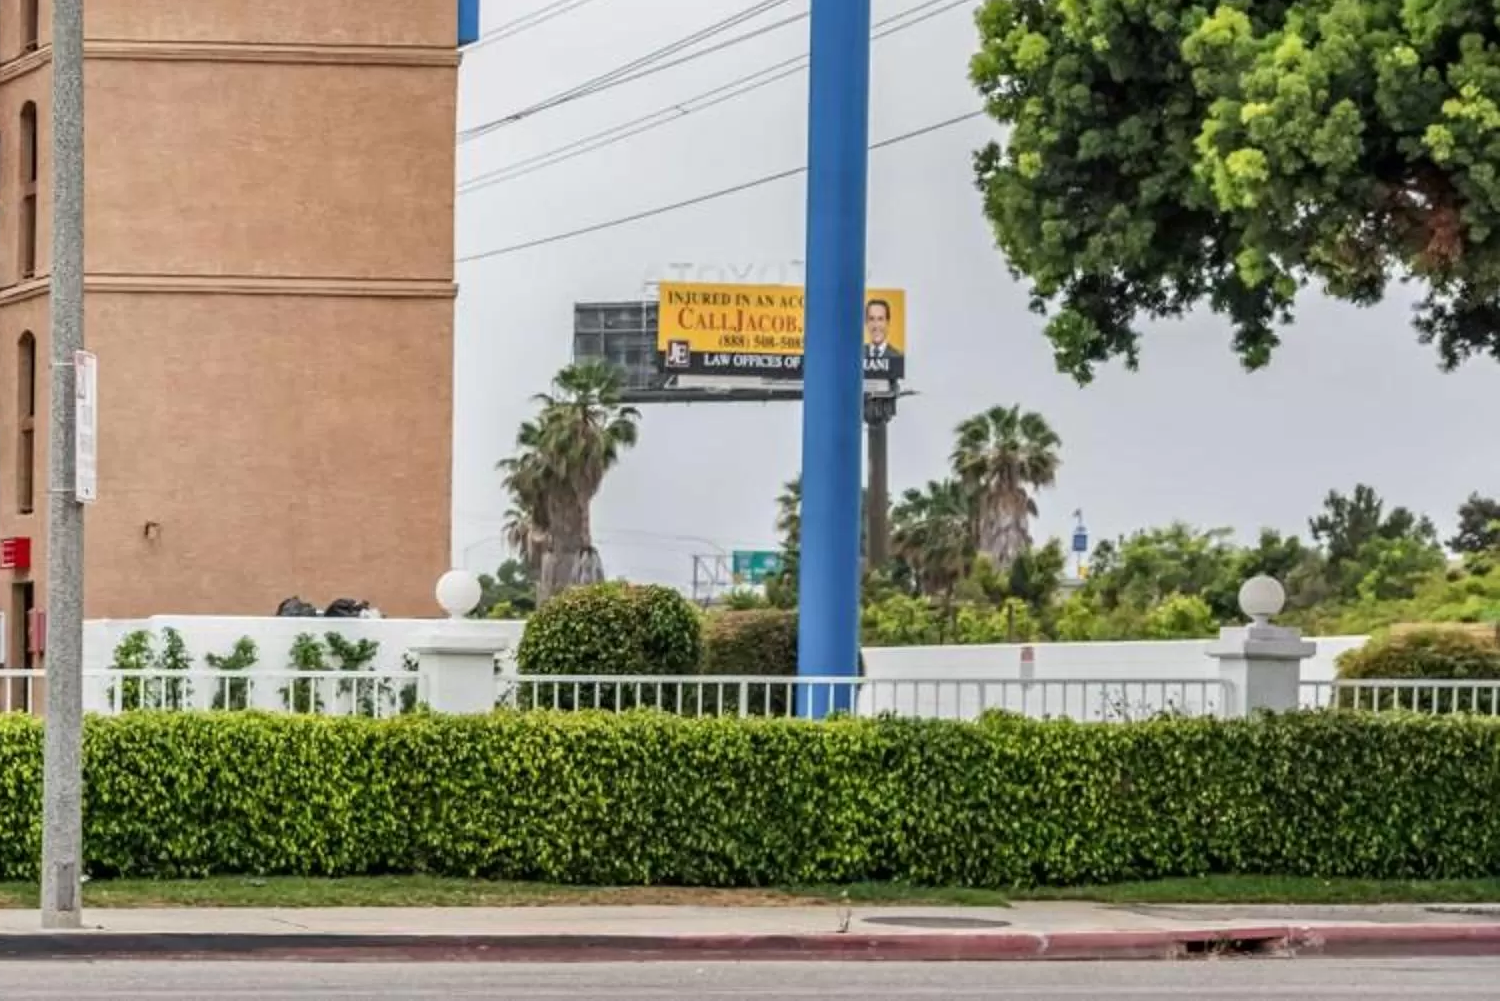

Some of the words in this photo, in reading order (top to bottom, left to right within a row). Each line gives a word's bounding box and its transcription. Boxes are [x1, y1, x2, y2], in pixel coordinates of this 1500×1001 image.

[667, 290, 731, 306] INJURED
[735, 293, 751, 306] IN
[756, 294, 776, 307] AN
[703, 353, 731, 367] LAW
[732, 354, 782, 368] OFFICES
[783, 355, 801, 369] OF
